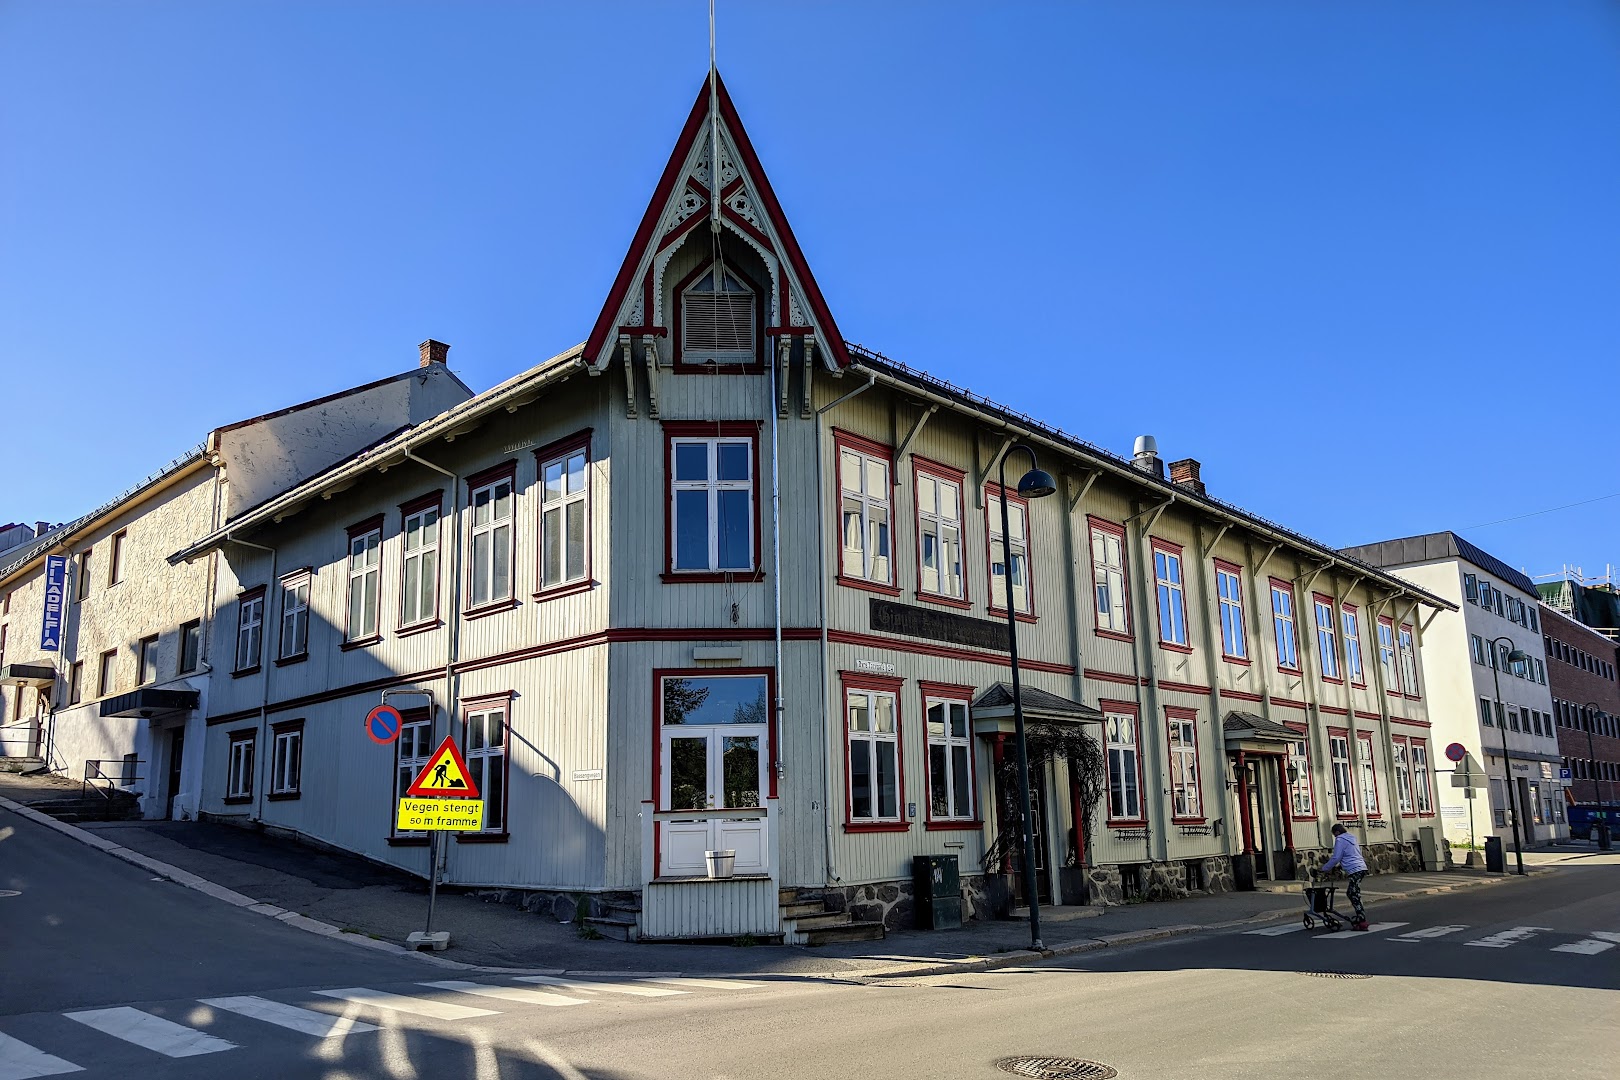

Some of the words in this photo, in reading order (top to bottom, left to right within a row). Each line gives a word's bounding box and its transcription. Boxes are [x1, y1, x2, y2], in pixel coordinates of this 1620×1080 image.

[43, 560, 63, 647] FILADELFIA
[1561, 769, 1569, 778] P
[404, 801, 439, 814] Vegen
[443, 803, 479, 815] stengt
[409, 817, 422, 825] 50
[424, 817, 433, 826] m
[437, 816, 478, 827] framme
